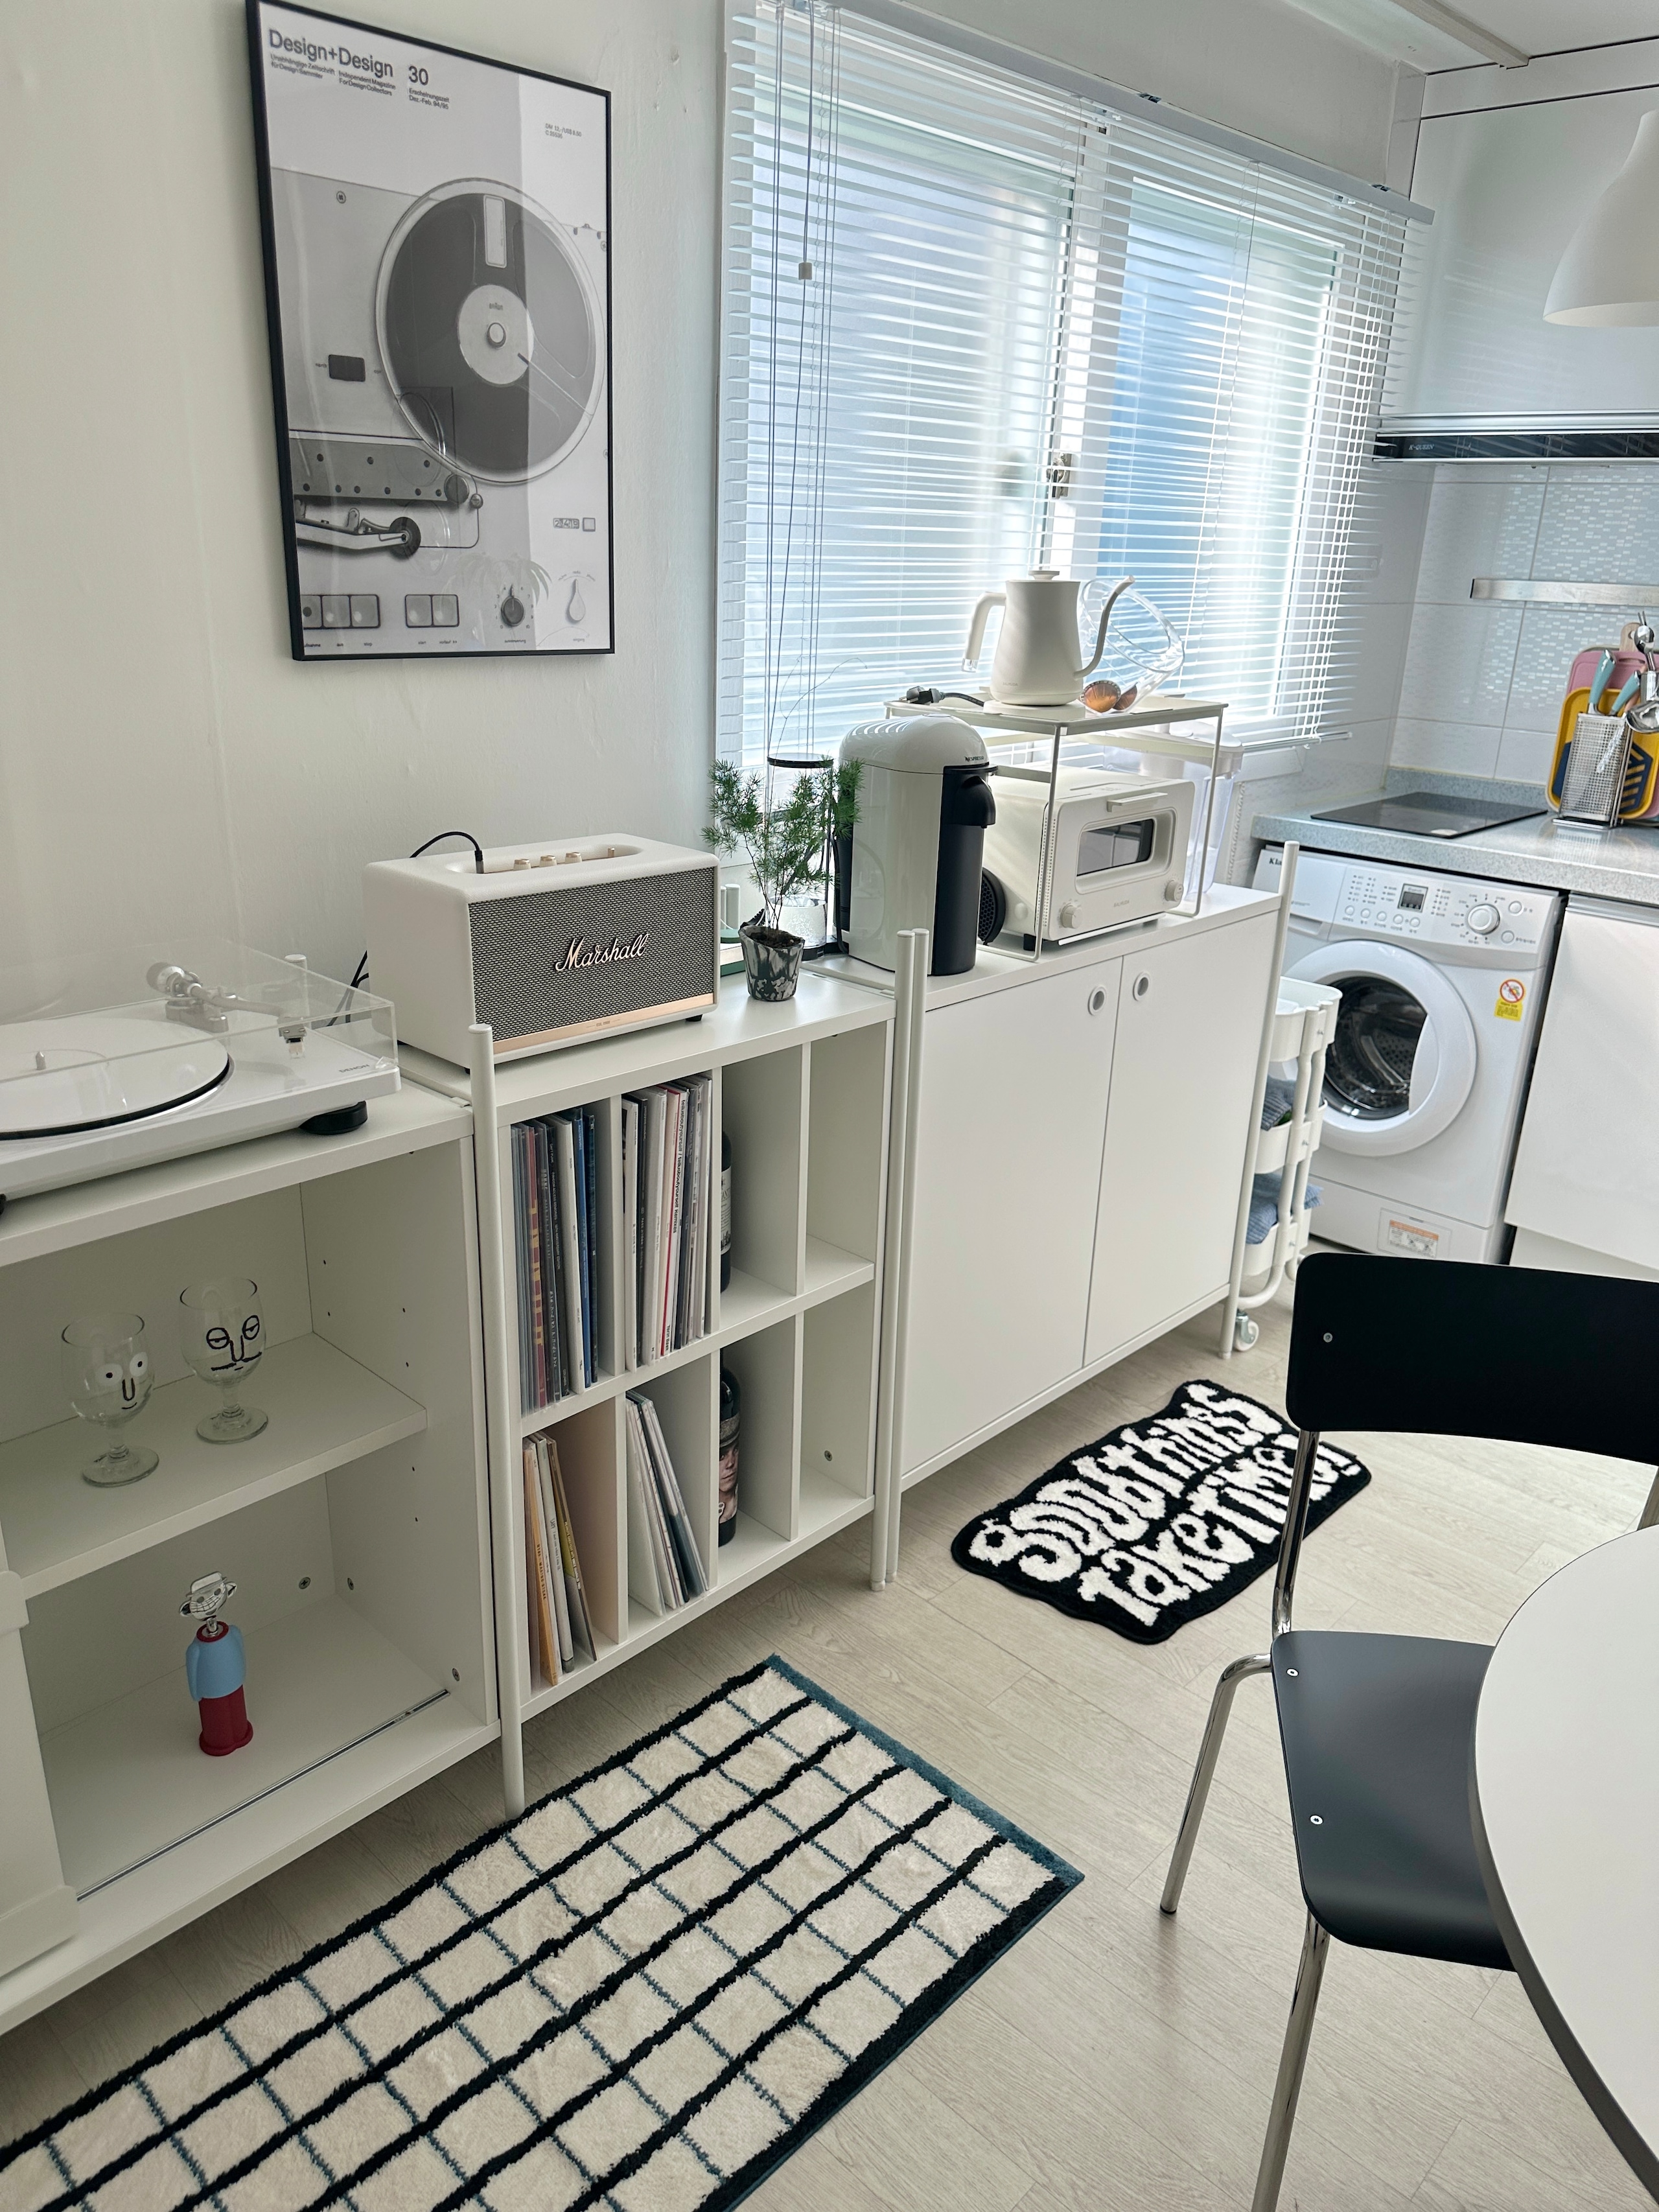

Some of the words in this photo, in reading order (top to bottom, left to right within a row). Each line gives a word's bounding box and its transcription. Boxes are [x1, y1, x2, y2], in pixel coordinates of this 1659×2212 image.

[270, 29, 393, 78] Design+Design
[408, 65, 428, 86] 30
[279, 64, 298, 74] Design
[338, 70, 371, 84] Independent
[371, 78, 396, 90] Magazine
[349, 80, 367, 91] Design
[367, 84, 392, 96] Collectors
[555, 933, 649, 972] Marshall
